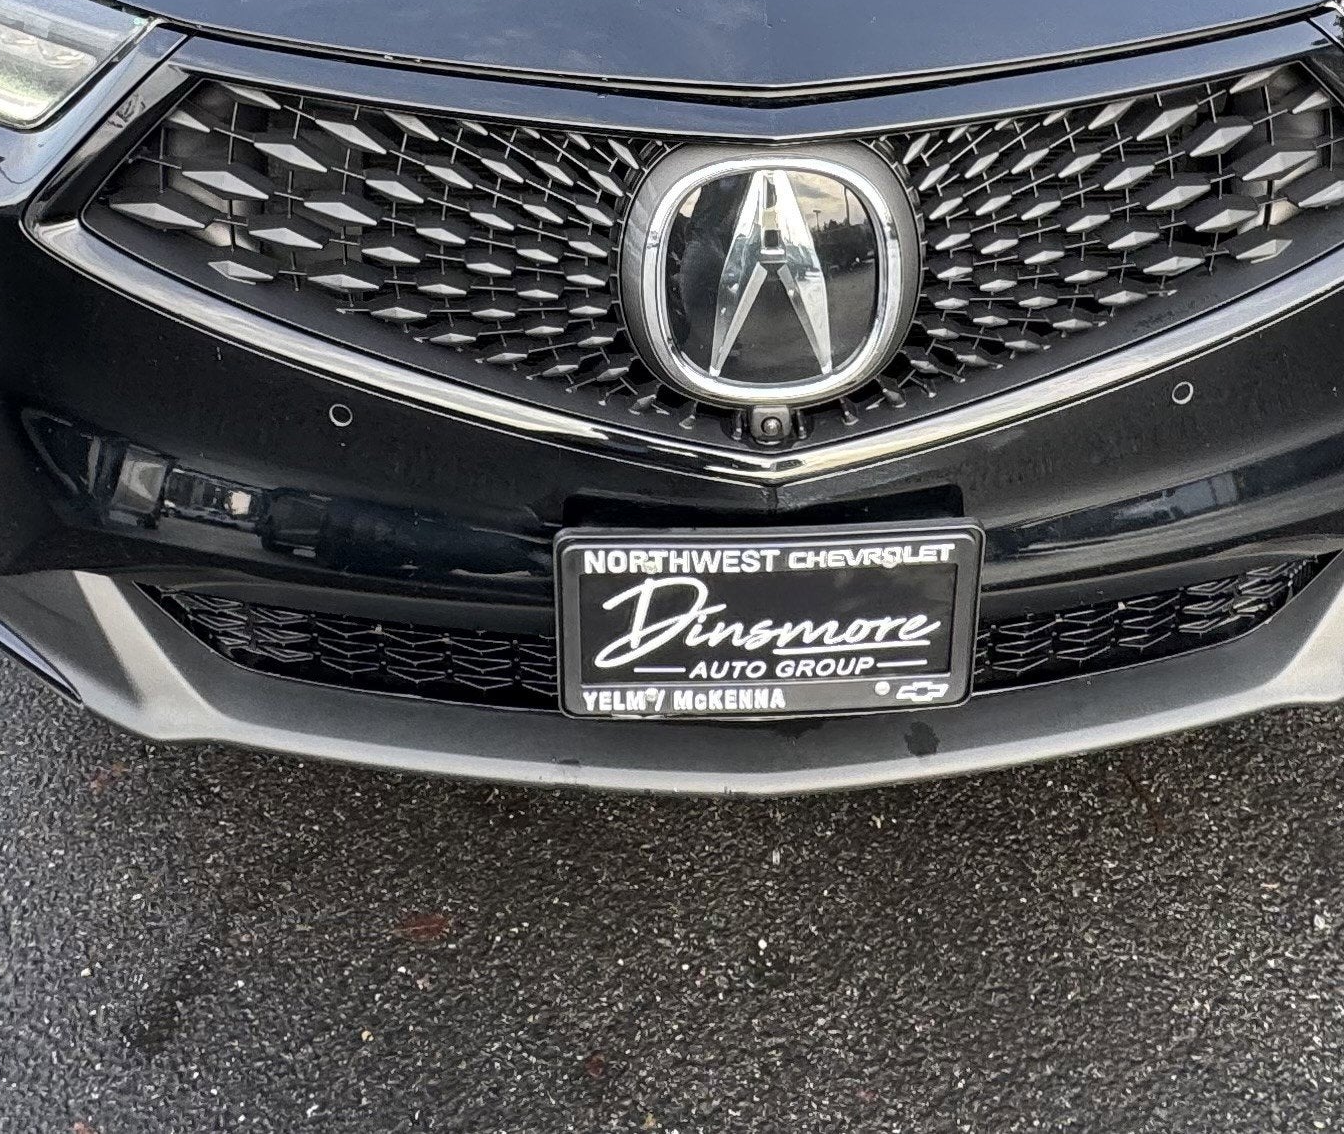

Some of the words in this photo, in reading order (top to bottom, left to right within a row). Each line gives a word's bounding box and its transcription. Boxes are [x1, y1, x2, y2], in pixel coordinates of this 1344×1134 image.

[584, 548, 781, 574] NORTHWEST
[788, 543, 955, 569] CHEVROLET
[594, 576, 941, 668] Dinsmore
[688, 661, 765, 679] AUTO
[775, 656, 875, 678] GROUP
[673, 688, 787, 711] McKENNA
